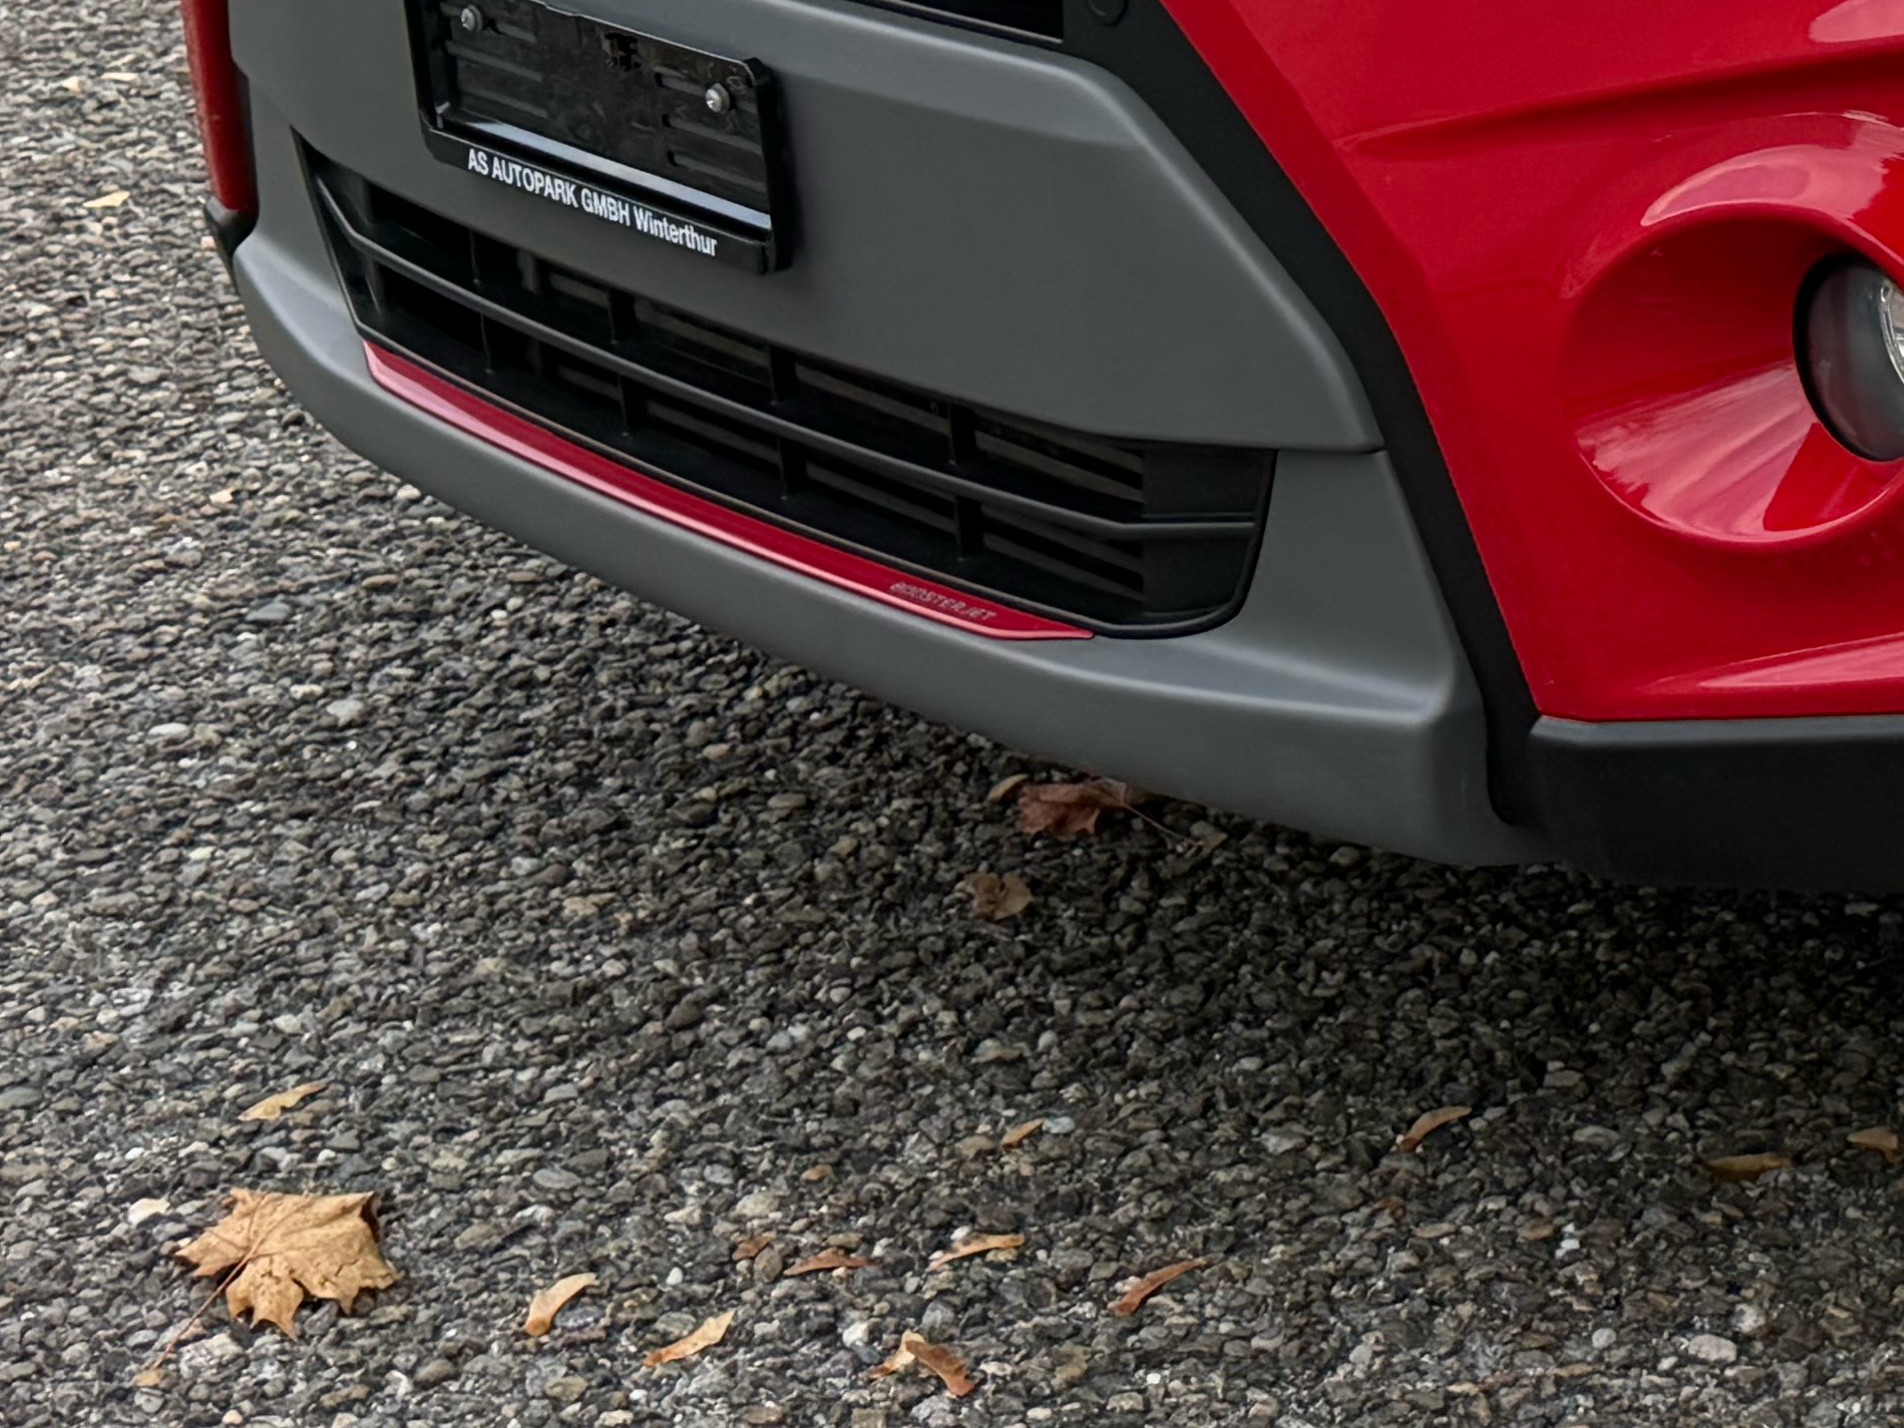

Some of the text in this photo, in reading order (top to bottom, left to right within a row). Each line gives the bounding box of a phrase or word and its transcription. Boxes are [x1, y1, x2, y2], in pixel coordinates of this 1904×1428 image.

[467, 148, 718, 256] AS AUTOPARK GMBH Winterthur
